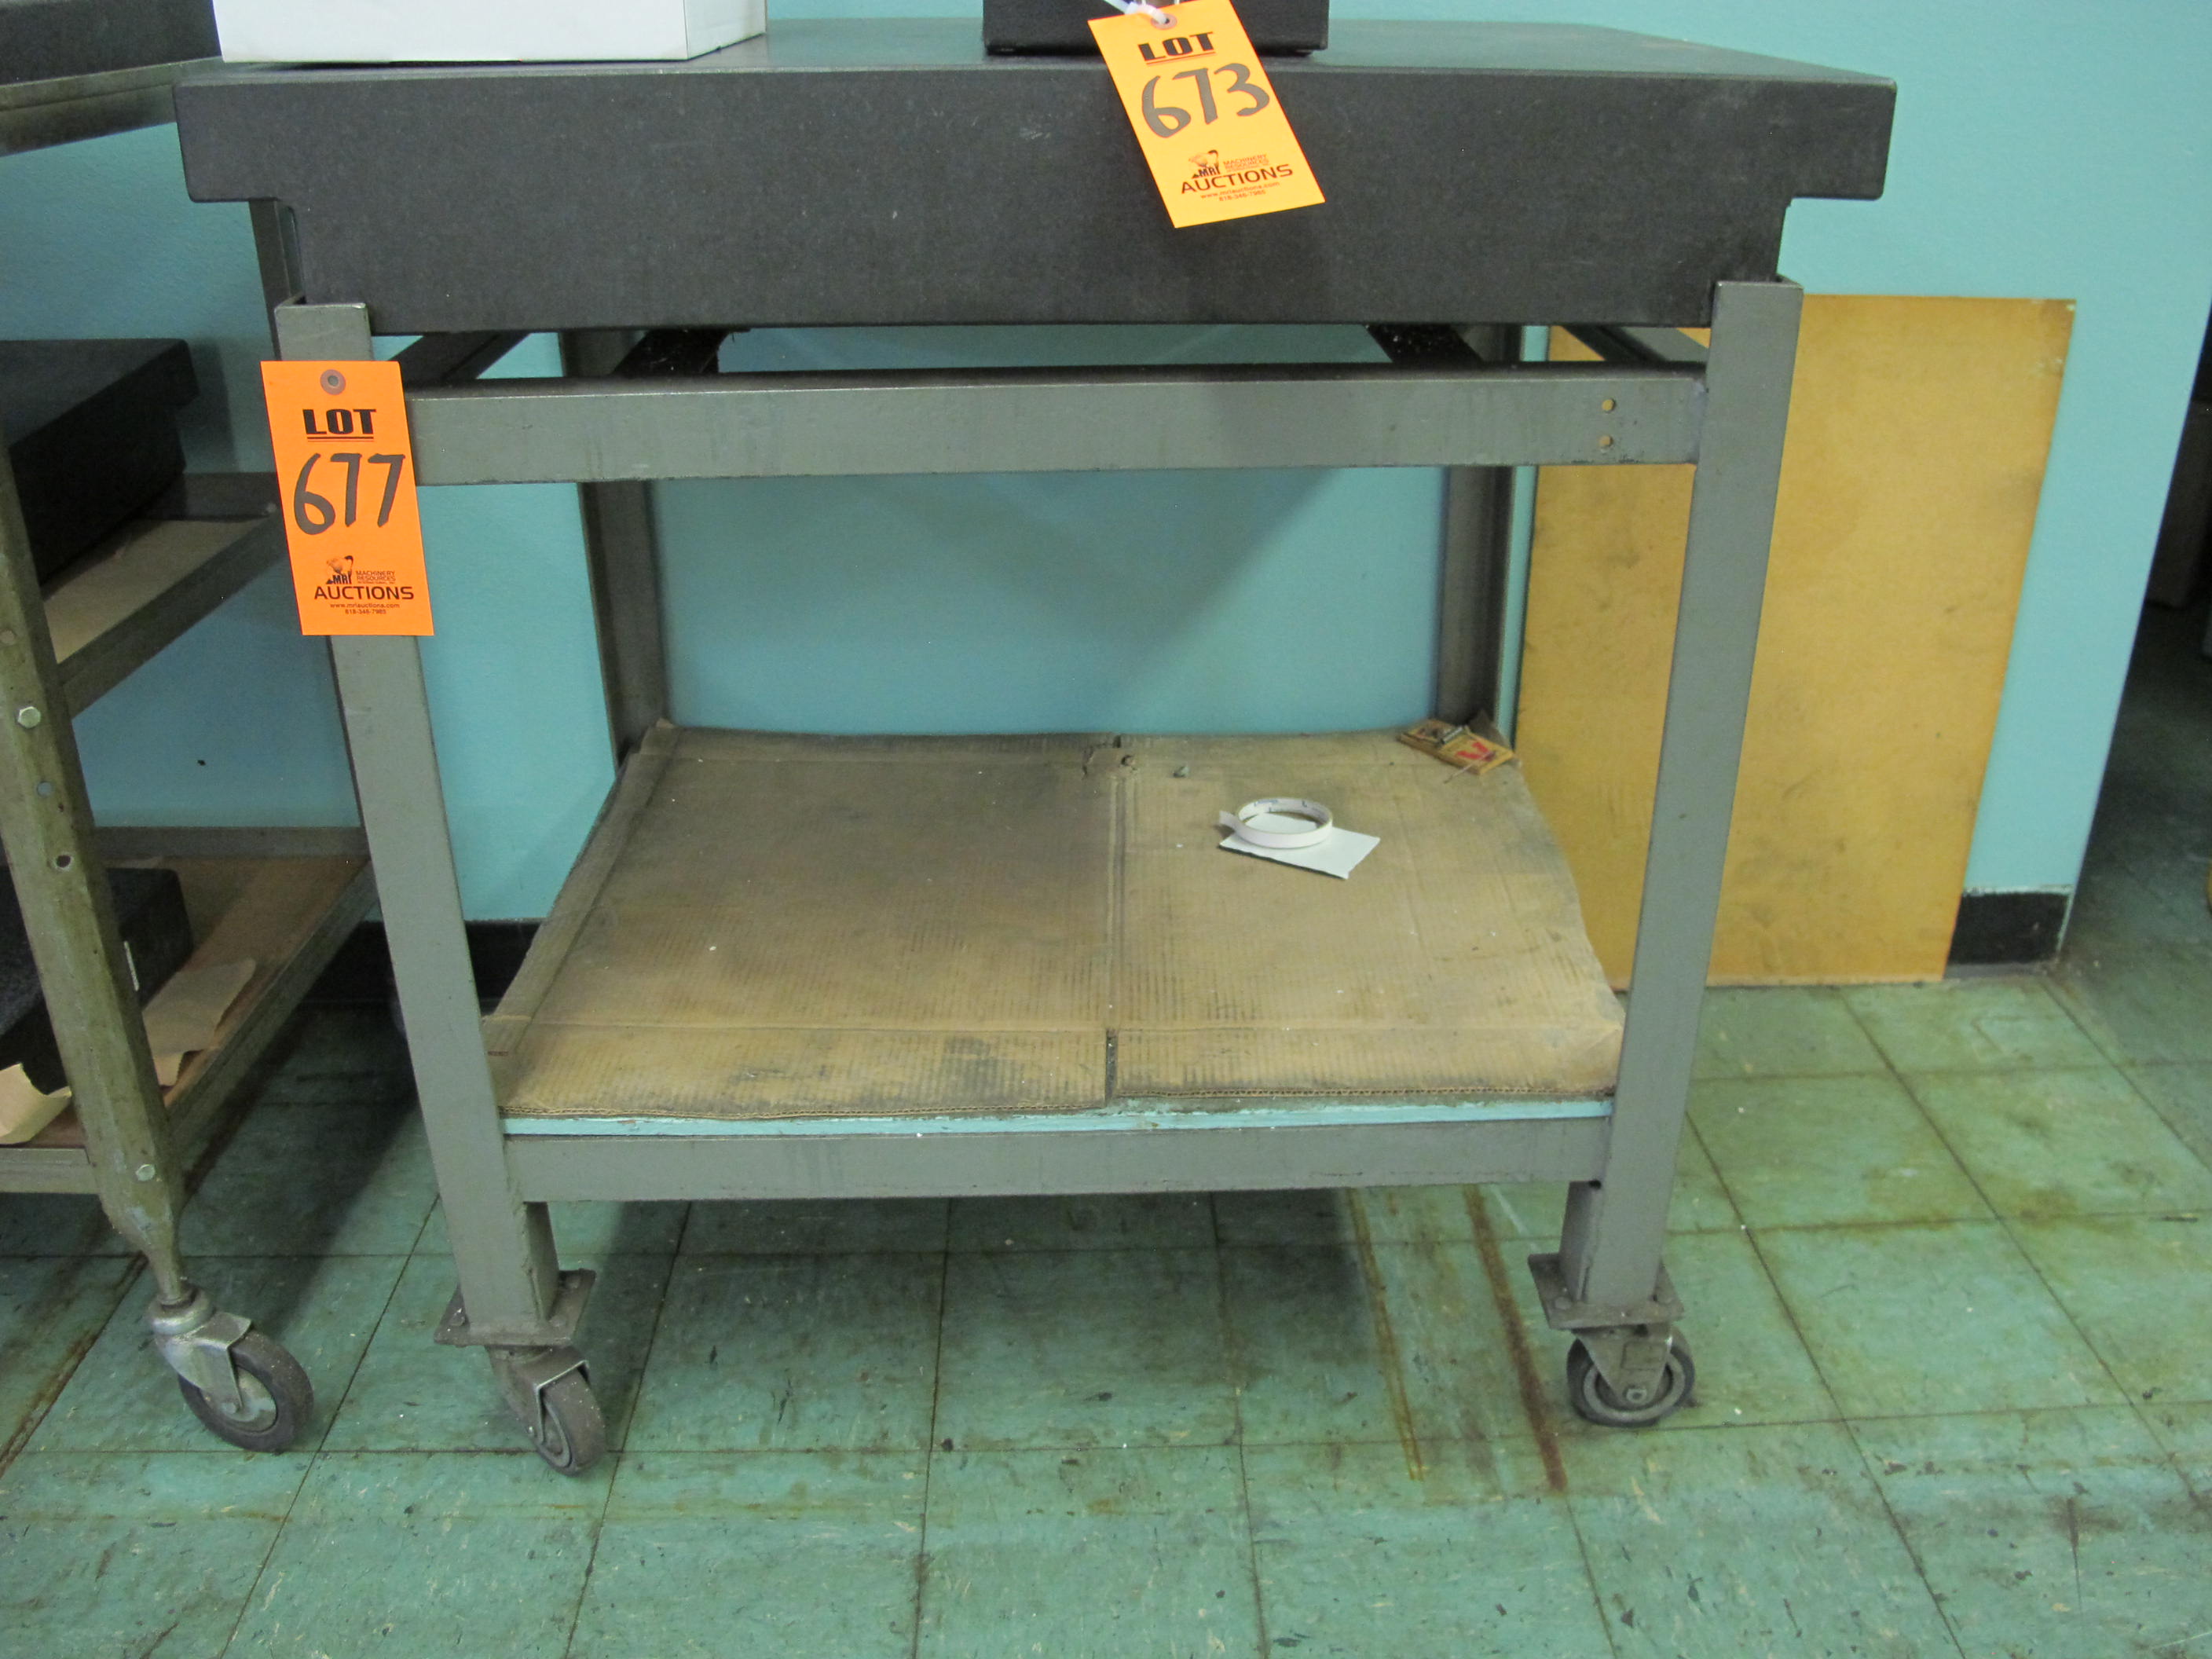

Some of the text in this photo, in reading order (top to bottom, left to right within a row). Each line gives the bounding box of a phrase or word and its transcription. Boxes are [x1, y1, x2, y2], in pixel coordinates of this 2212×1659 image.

[1138, 31, 1215, 61] LOT
[1142, 63, 1270, 138] 673
[1181, 164, 1293, 194] AUCTIONS
[302, 409, 376, 434] LOT
[294, 453, 406, 535] 677
[314, 586, 414, 599] AUCTIONS
[333, 574, 352, 584] MRI
